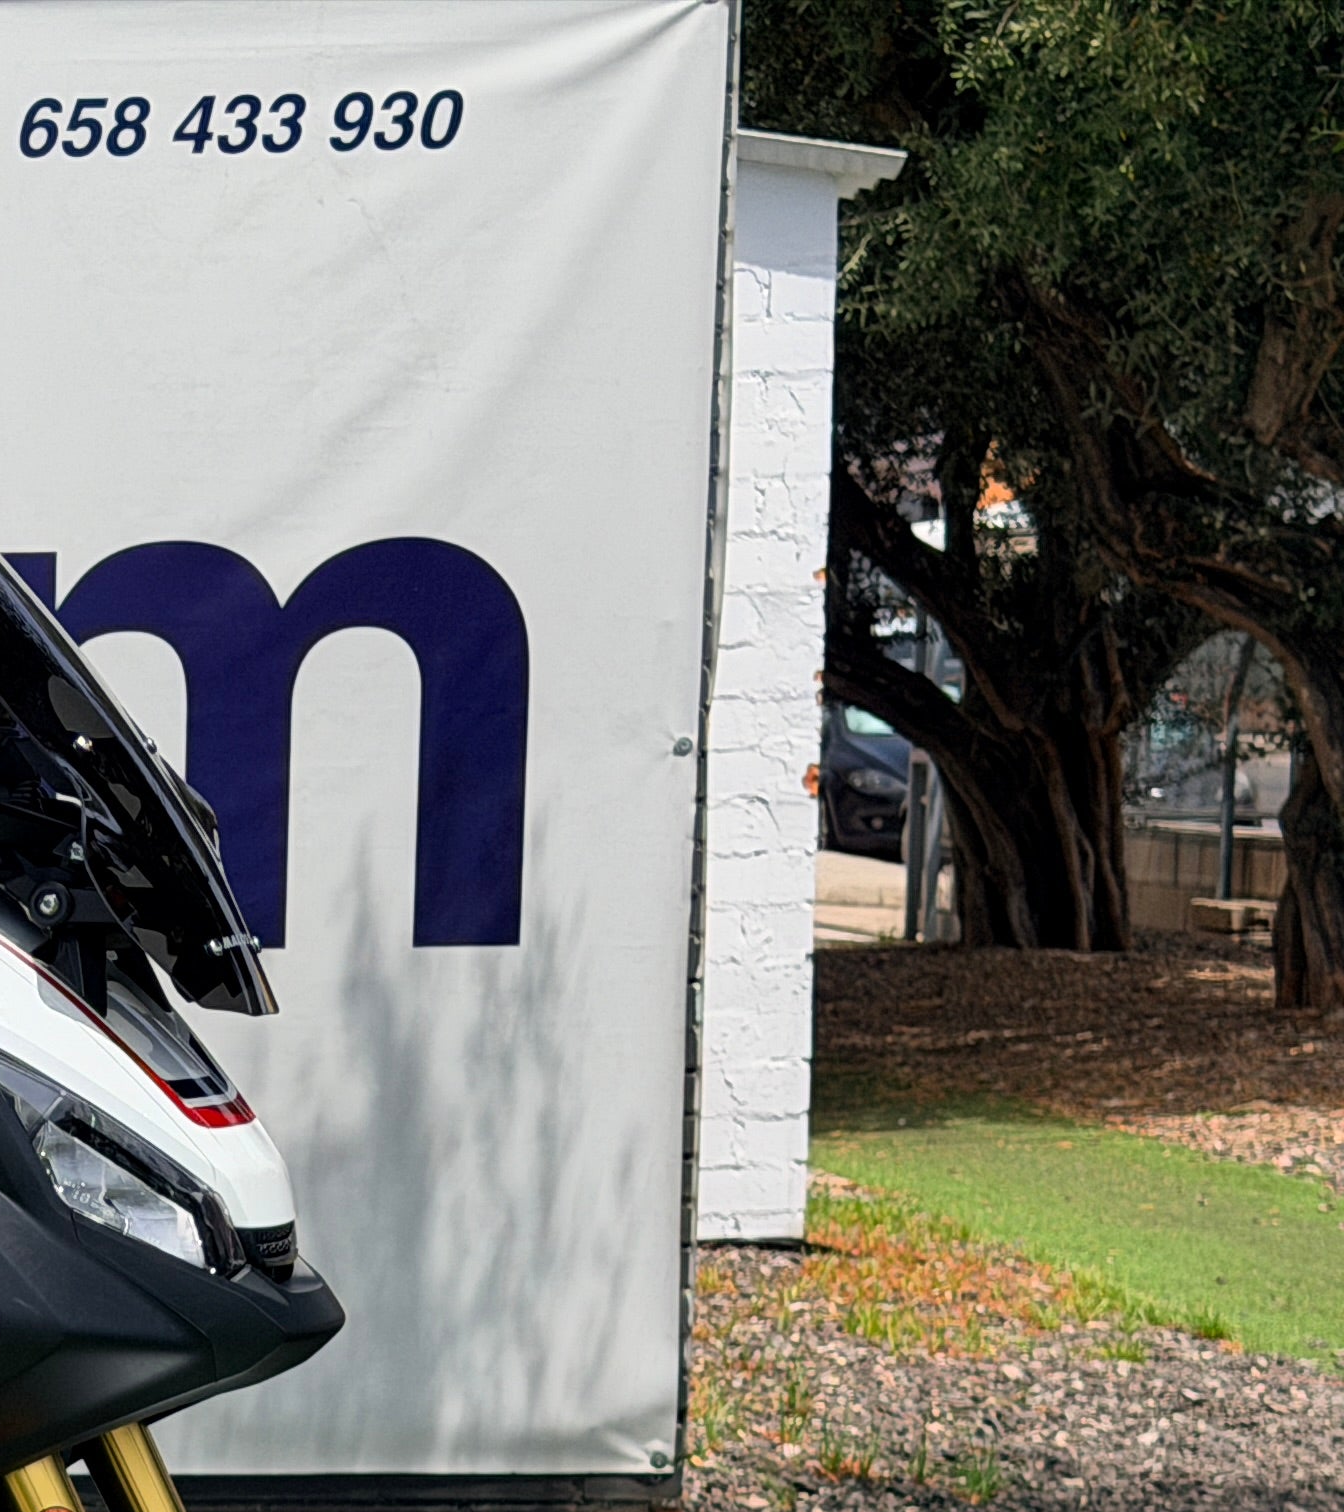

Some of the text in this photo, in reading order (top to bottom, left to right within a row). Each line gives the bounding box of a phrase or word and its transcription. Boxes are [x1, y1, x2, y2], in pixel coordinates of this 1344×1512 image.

[17, 89, 464, 158] 658 433 930
